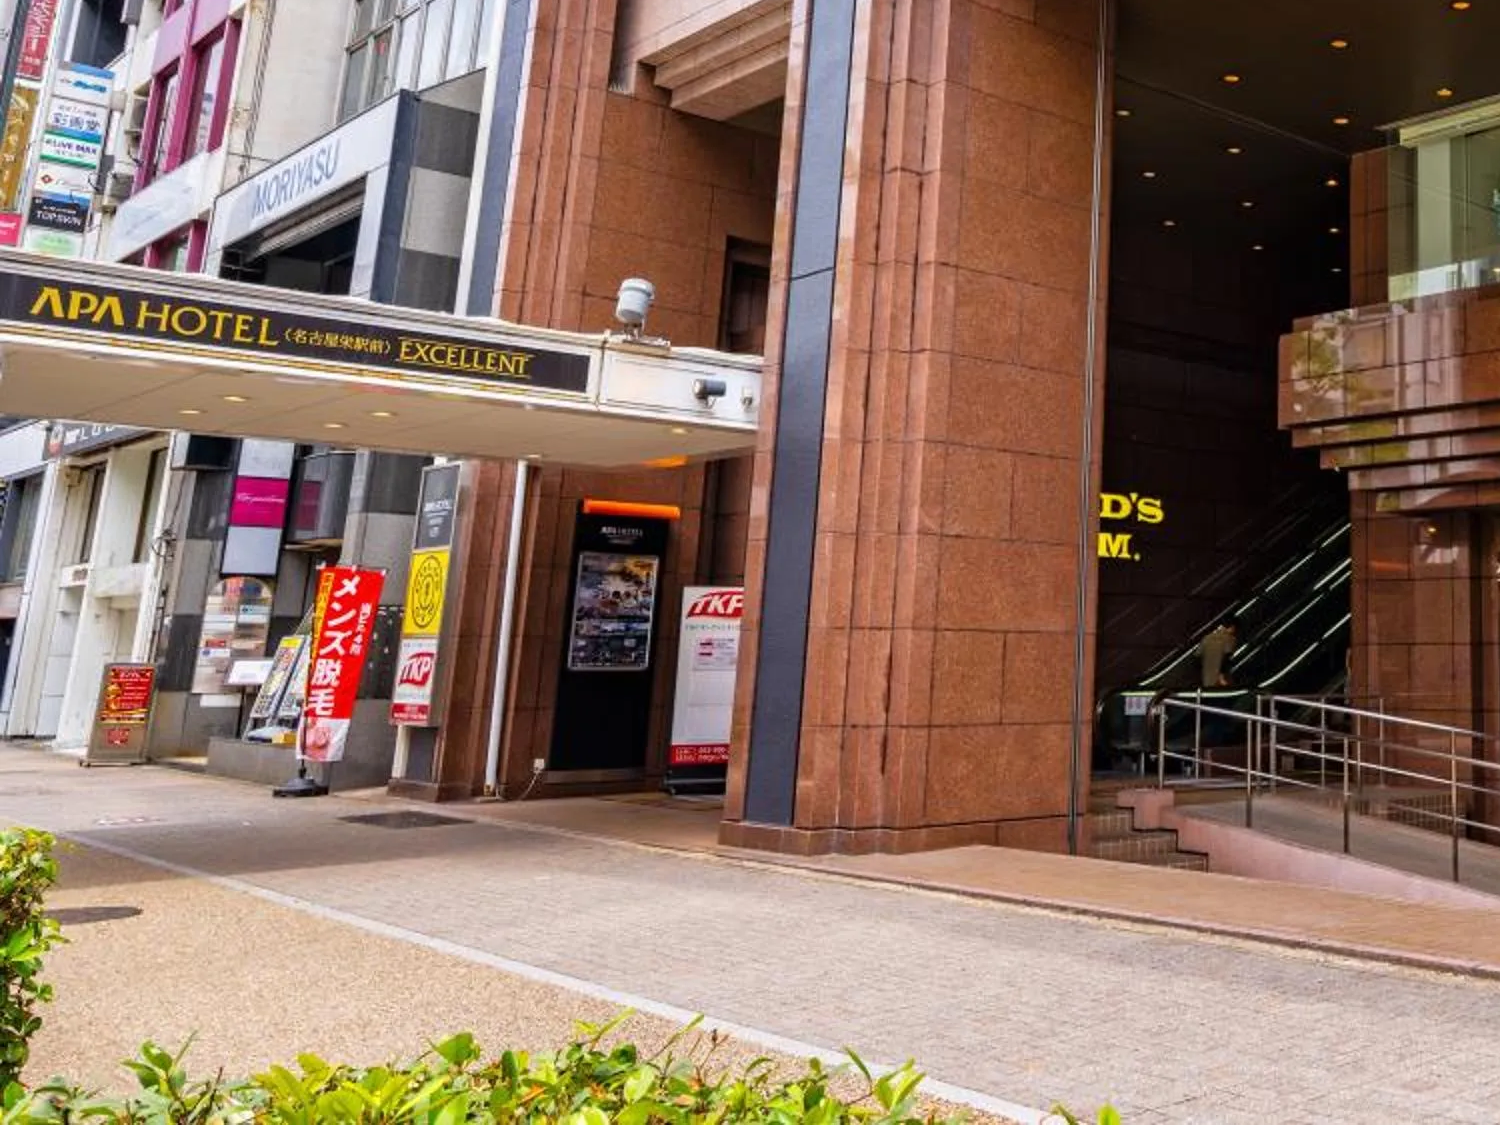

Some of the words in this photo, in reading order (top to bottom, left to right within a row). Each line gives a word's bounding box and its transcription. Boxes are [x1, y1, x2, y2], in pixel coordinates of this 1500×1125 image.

[252, 139, 342, 218] MORIYASU
[29, 286, 125, 326] APA
[136, 299, 279, 347] HOTEL
[401, 340, 530, 374] EXCELLENT
[308, 574, 361, 717] メンズ脱毛
[402, 658, 432, 683] TKP
